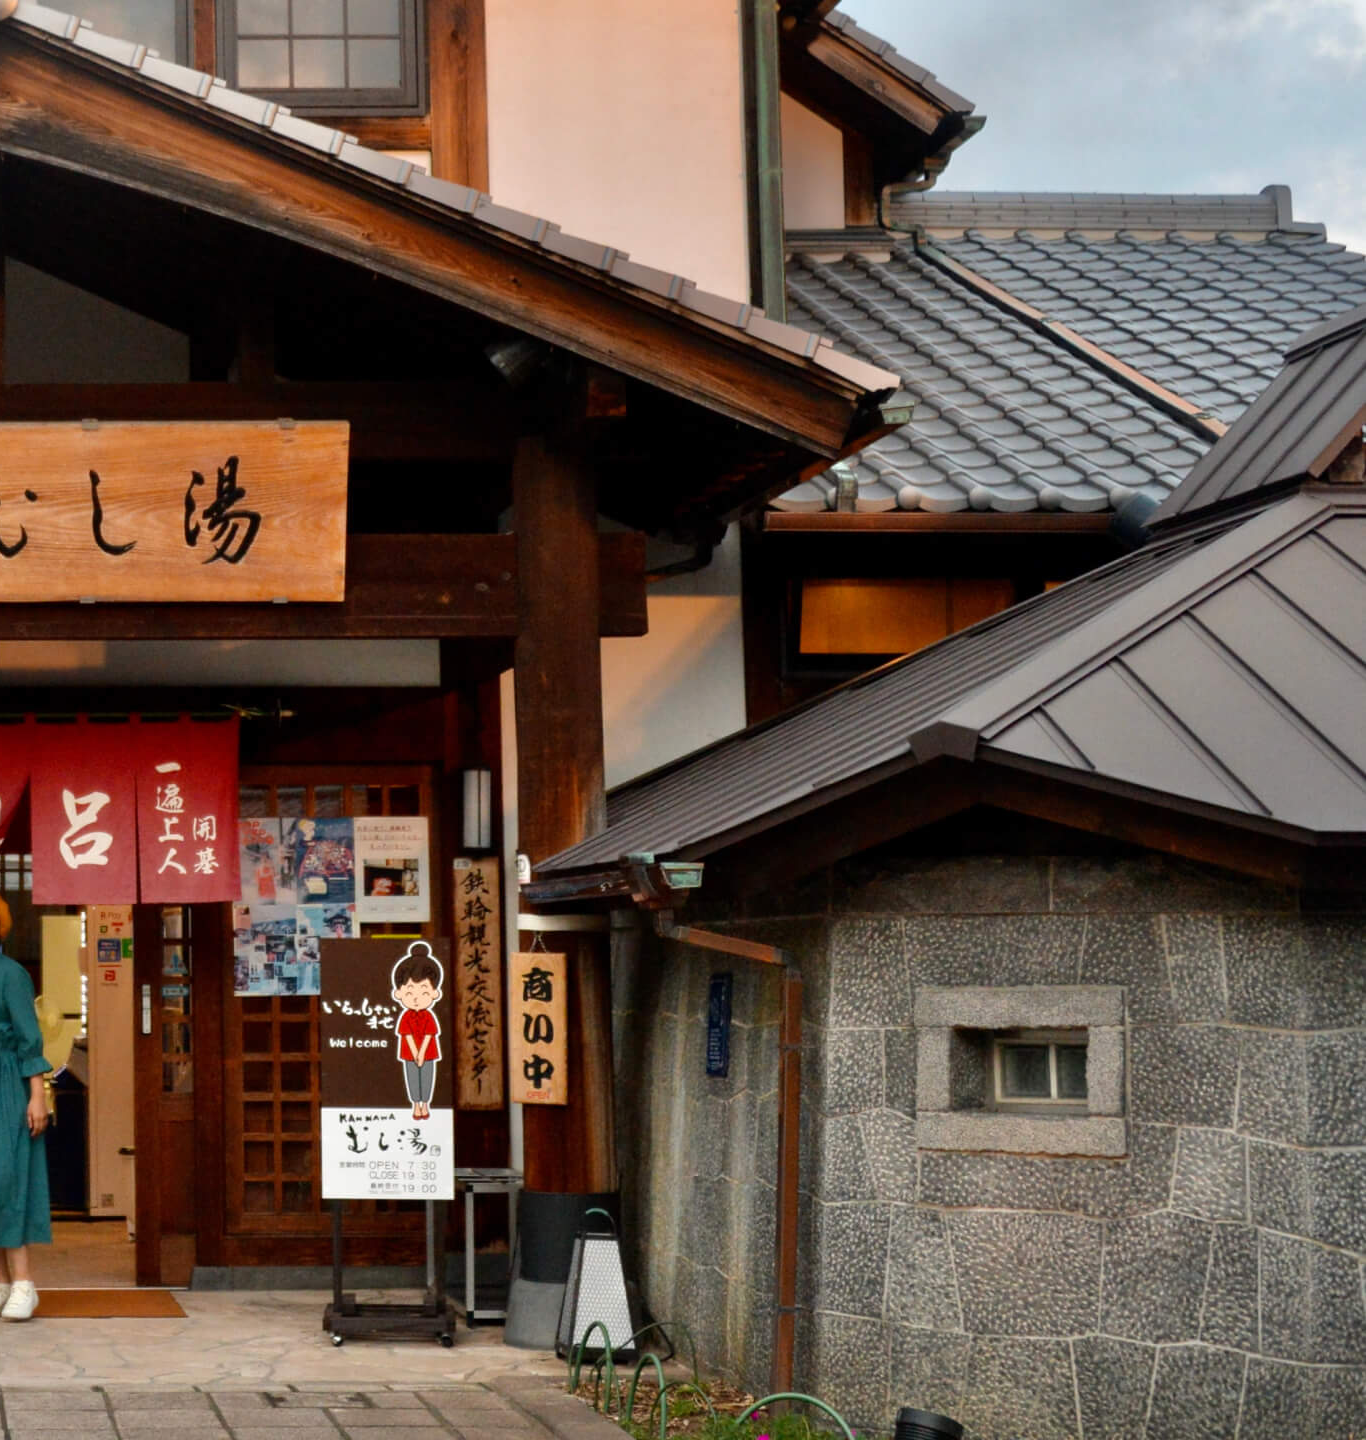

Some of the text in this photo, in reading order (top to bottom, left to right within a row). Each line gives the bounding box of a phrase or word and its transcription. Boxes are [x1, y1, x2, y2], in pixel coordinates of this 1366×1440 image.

[154, 761, 187, 875] 一遍上人
[192, 815, 220, 875] 開基
[322, 998, 397, 1016] いらっしゃい
[522, 967, 555, 1089] 商い中
[329, 1037, 388, 1048] Welcome
[346, 1125, 428, 1155] むし湯
[369, 1161, 400, 1170] OPEN
[369, 1171, 399, 1180] CLOSE
